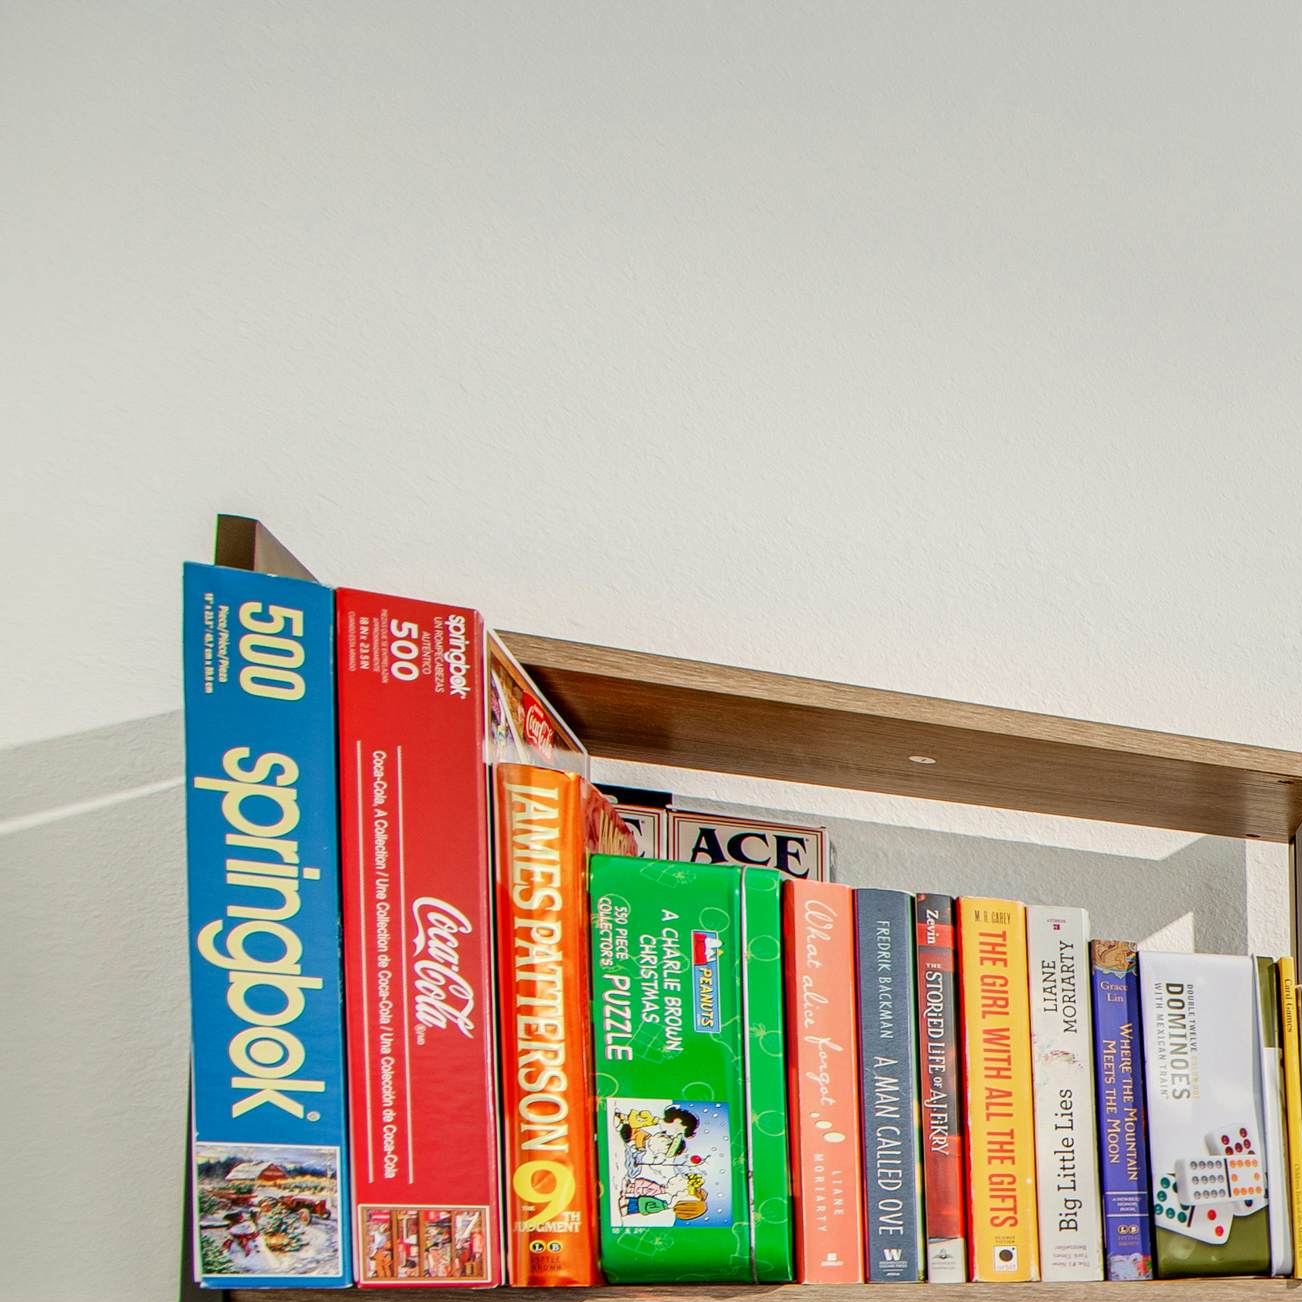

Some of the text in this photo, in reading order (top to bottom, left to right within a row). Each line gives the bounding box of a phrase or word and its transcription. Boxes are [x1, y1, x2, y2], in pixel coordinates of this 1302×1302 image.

[239, 602, 305, 700] 500
[390, 619, 419, 681] 500
[422, 632, 434, 675] AUTÉNTICO
[434, 617, 445, 693] UN ROMPECABEZAS
[444, 614, 471, 695] springbok
[692, 827, 810, 880] ACE
[194, 747, 326, 1120] springbok
[615, 928, 629, 961] PIECE
[803, 899, 838, 969] What
[926, 909, 941, 945] Zevin
[979, 931, 1007, 967] THE
[372, 751, 398, 1179] Coca-Cola, A Collection Une Collection de Coca-Cola Una Colección de Coca-Cola
[413, 897, 474, 1038] Coca-Cola
[503, 783, 569, 1153] JAMES PATTERSON
[640, 933, 660, 1024] CHRISTMAS
[662, 909, 684, 1053] A CHARLIE BROWN
[876, 920, 893, 1040] FREDRIK BACKMAN
[1042, 960, 1058, 1013] LIANE
[1060, 940, 1078, 1033] MORIARTY
[1100, 981, 1128, 992] Grace
[1284, 978, 1294, 1000] Card
[603, 974, 633, 1062] PUZZLE
[700, 967, 715, 1027] PEANUTS
[981, 974, 1010, 1019] GIRL
[1186, 984, 1196, 1016] DOUBLE
[874, 1056, 899, 1069] A
[983, 1027, 1012, 1079] WITH
[1155, 983, 1168, 1096] WITH MEXICAN TRAIN
[1166, 982, 1191, 1101] DOMINOES
[1189, 1020, 1198, 1052] TWELVE
[806, 1036, 844, 1116] forgot
[875, 1075, 900, 1121] MAN
[985, 1086, 1013, 1122] ALL
[877, 1126, 902, 1192] CALLED
[987, 1128, 1015, 1165] THE
[1054, 1089, 1083, 1232] Big Little Lies
[513, 1160, 576, 1226] 9
[814, 1153, 830, 1233] MORIARTY
[831, 1169, 845, 1217] LIANE
[878, 1198, 903, 1237] OVE
[988, 1173, 1018, 1228] GIFTS
